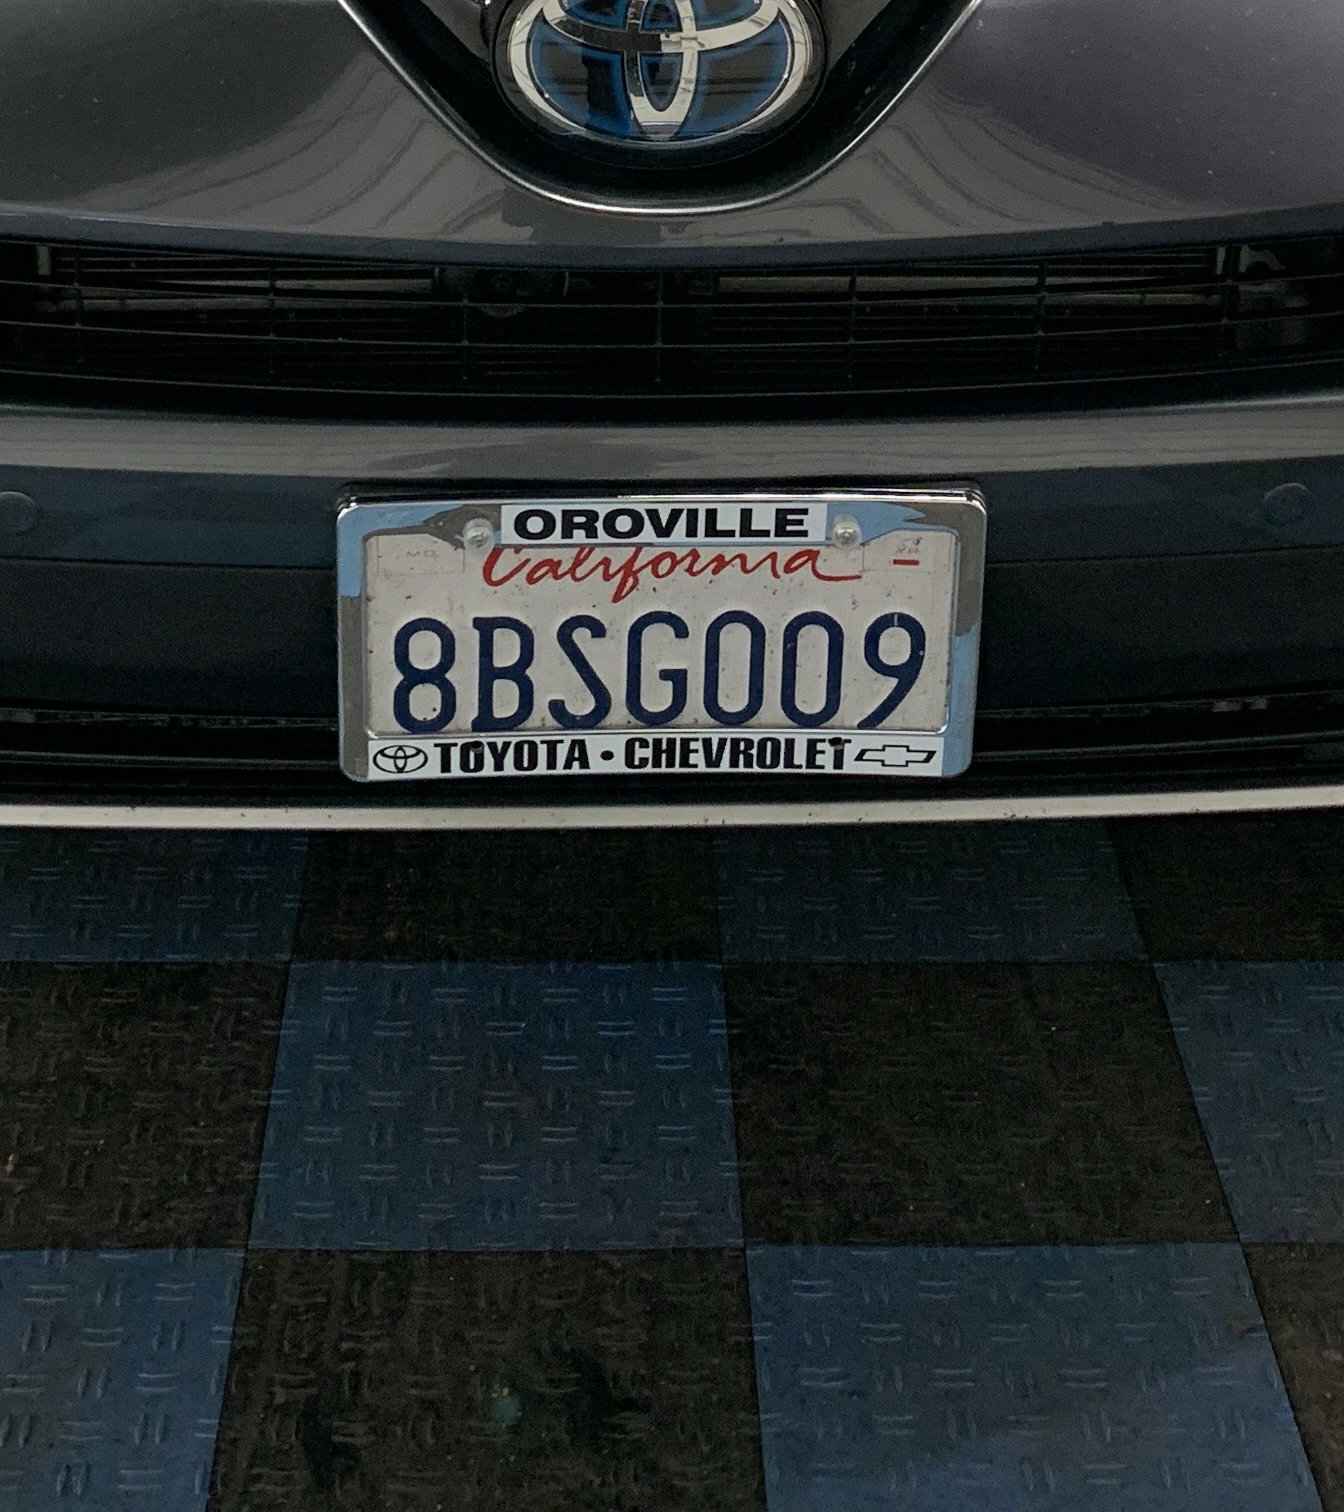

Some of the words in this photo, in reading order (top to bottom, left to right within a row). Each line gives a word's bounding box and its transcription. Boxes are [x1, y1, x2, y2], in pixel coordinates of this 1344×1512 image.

[513, 507, 809, 540] OROVILLE
[481, 545, 862, 603] California
[392, 610, 926, 734] 8BSG009
[433, 739, 590, 774] TOYOTA
[624, 736, 850, 772] CHEVROLET
